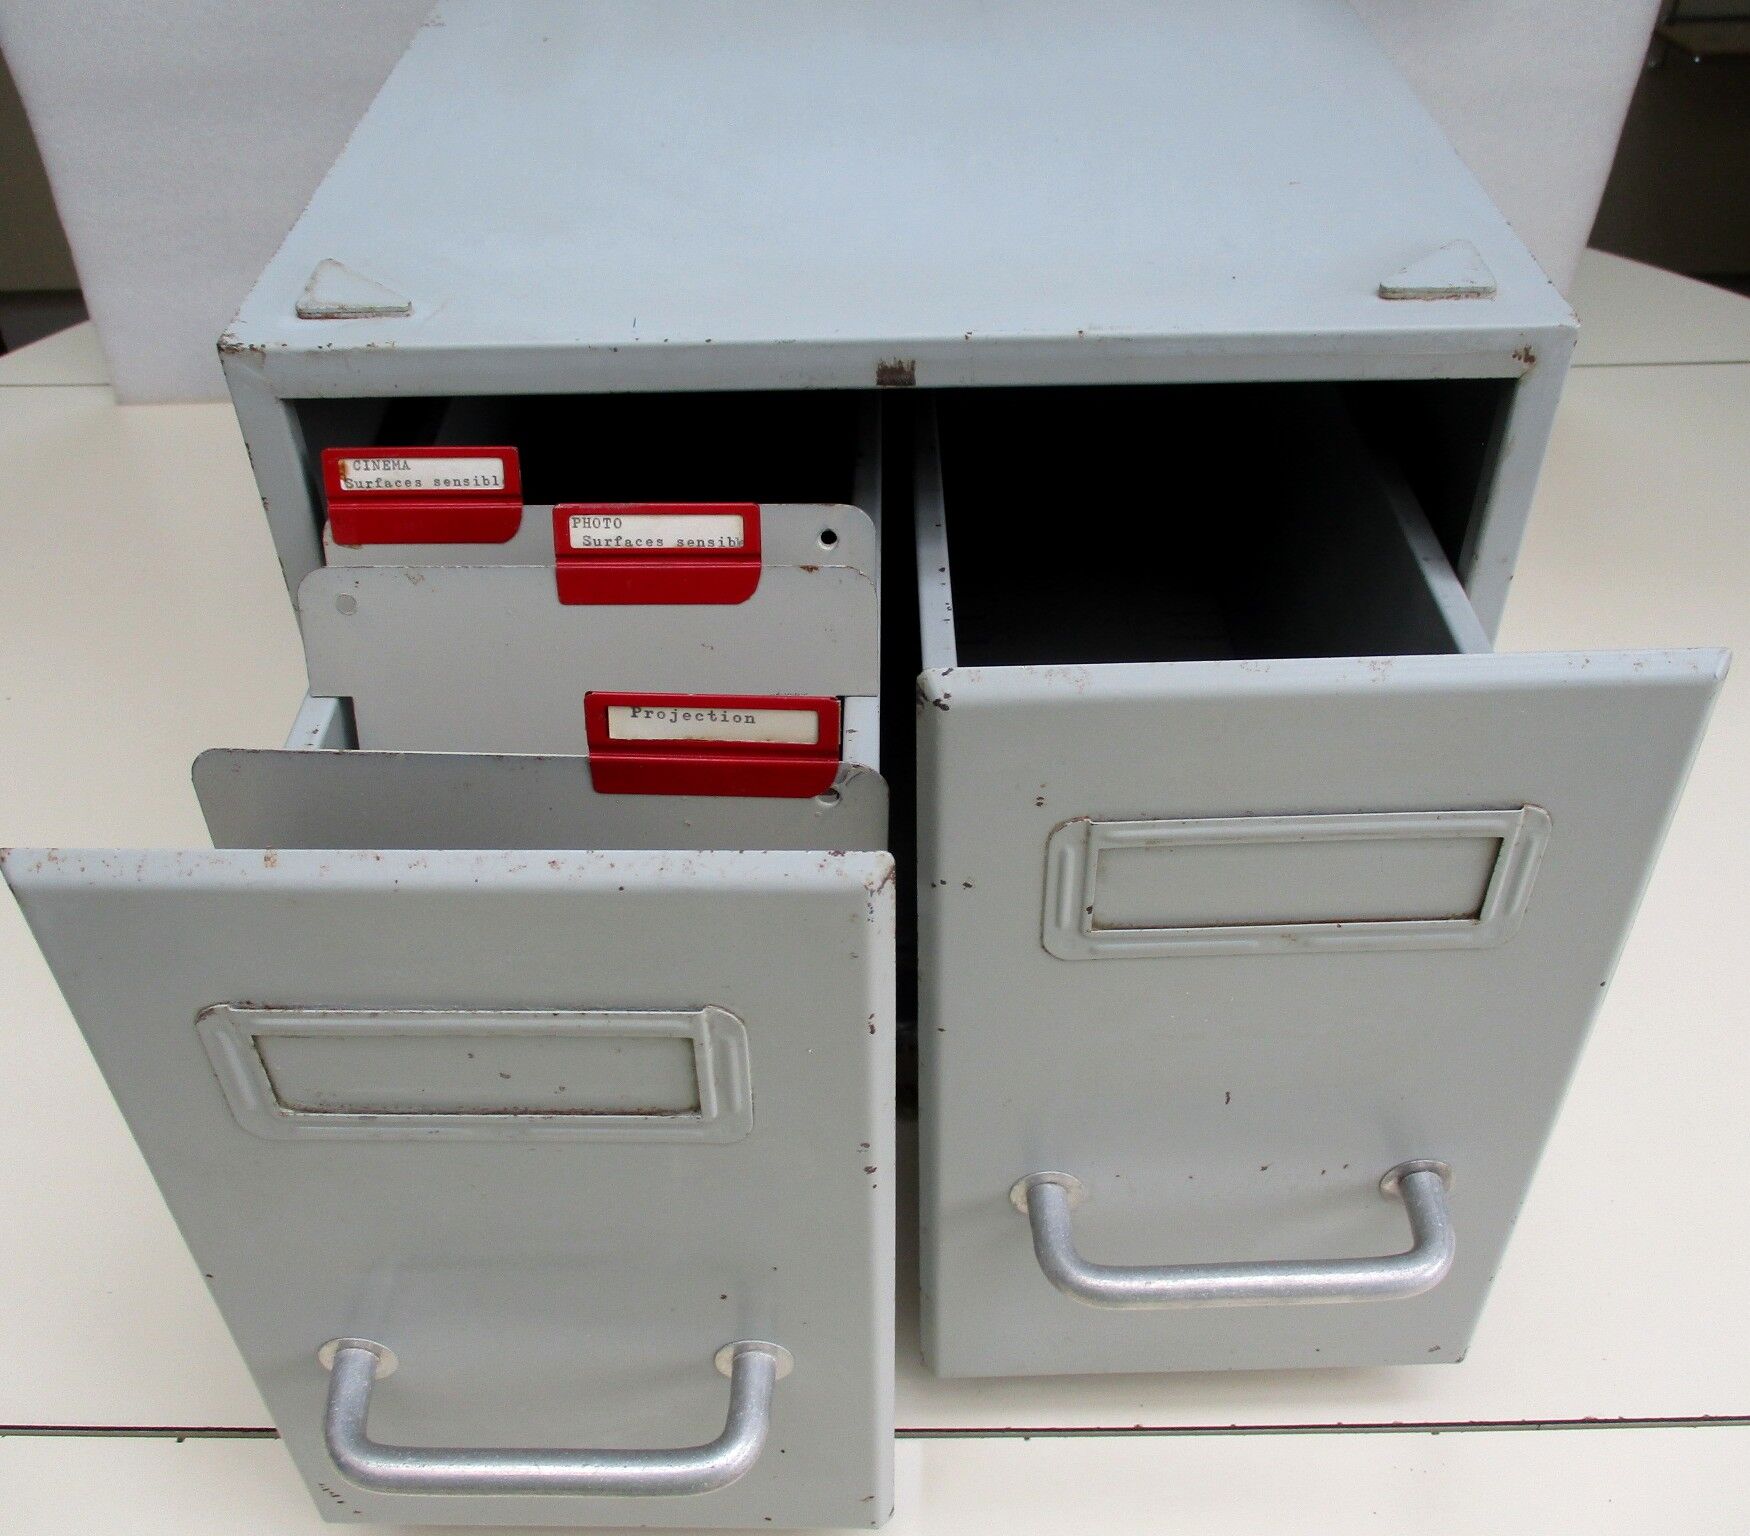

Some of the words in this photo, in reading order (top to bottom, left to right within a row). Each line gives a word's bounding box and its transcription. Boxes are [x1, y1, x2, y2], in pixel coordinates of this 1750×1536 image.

[352, 460, 411, 471] CINEMA
[345, 478, 422, 489] Surfaces
[571, 517, 622, 529] PHOTO
[582, 535, 664, 547] Surfaces
[630, 707, 756, 724] Projection
